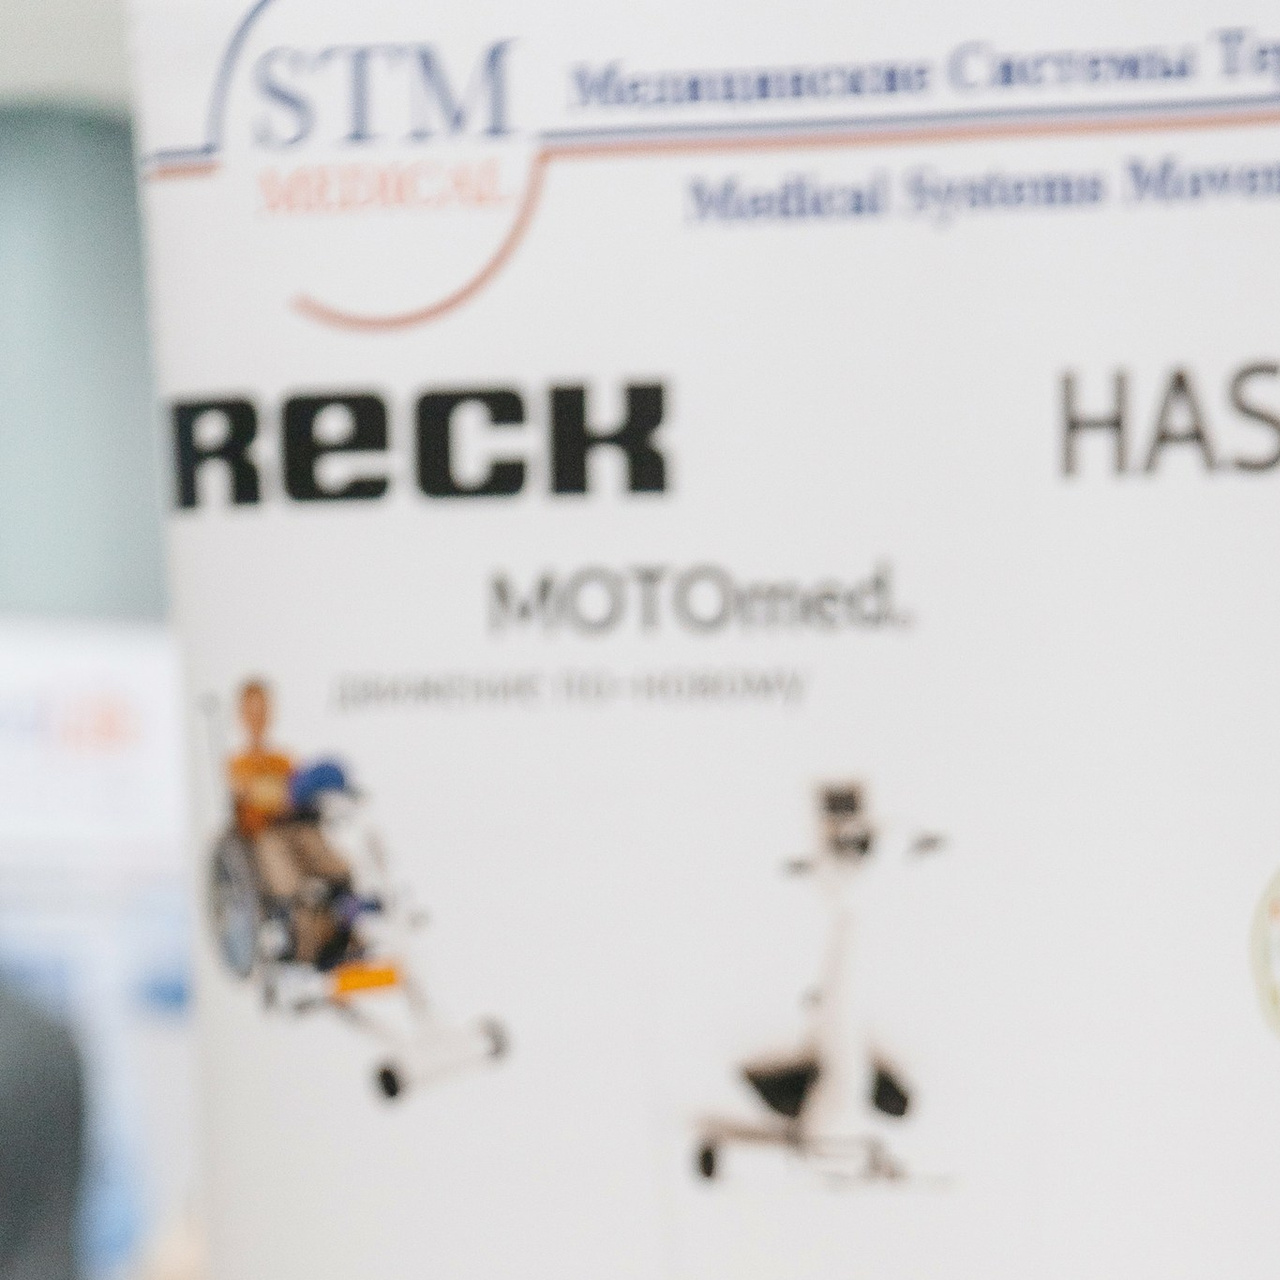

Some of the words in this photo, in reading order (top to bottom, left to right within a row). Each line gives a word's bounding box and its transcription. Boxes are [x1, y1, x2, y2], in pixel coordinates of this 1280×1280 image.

[252, 38, 516, 149] STM
[570, 60, 931, 110] Медицинские
[948, 42, 1194, 92] Системы
[257, 163, 511, 215] MEDICAL
[686, 170, 885, 224] Medical
[904, 160, 1106, 224] Systems
